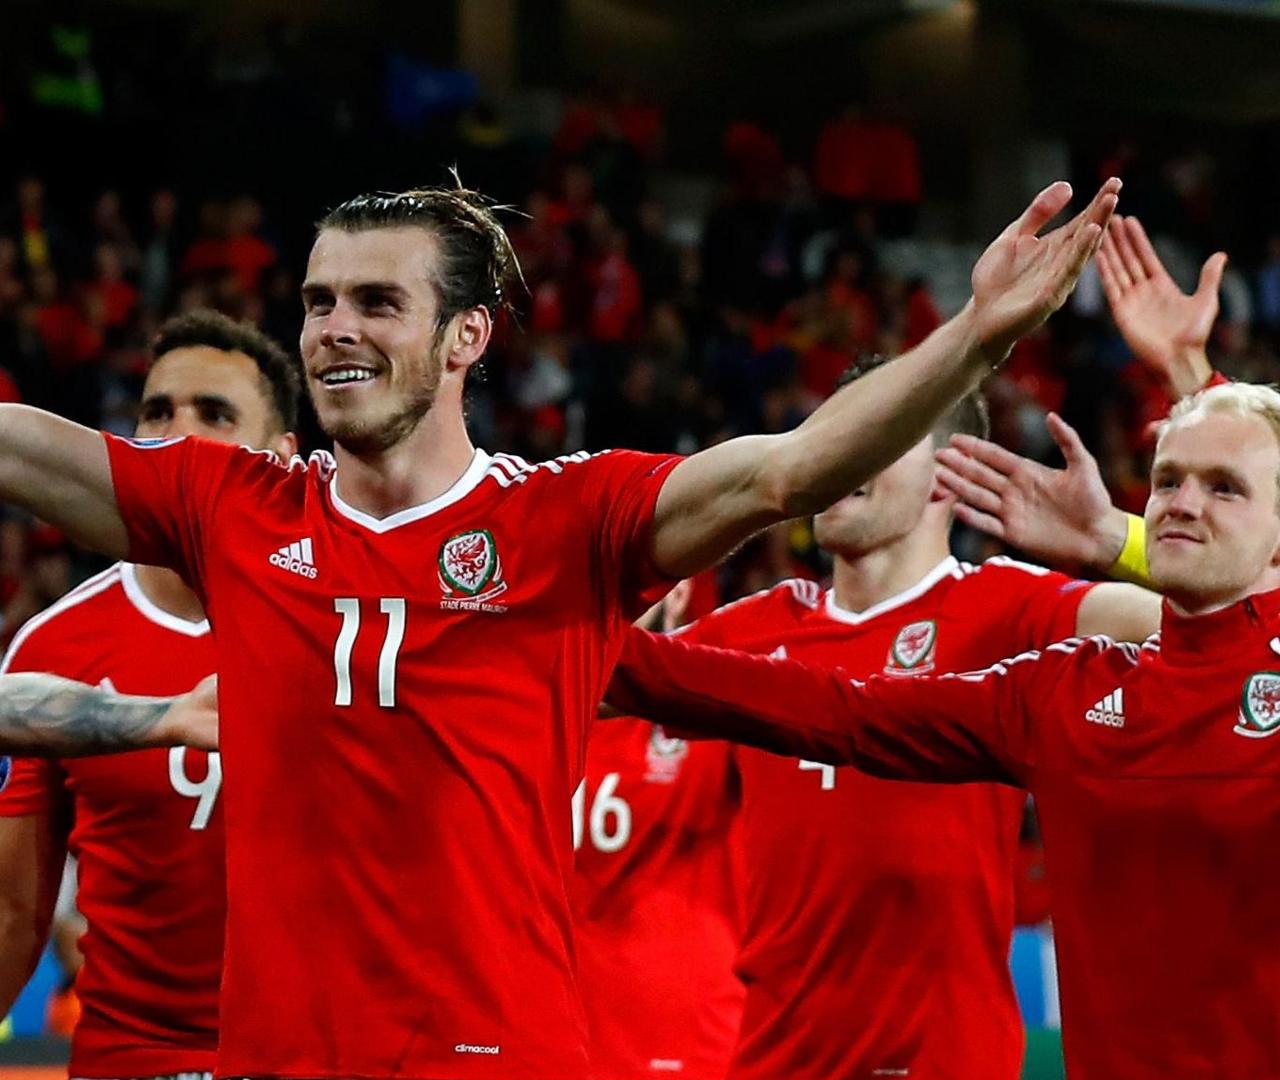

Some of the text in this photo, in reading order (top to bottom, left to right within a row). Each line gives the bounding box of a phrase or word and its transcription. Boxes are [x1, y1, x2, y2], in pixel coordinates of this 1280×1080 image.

[269, 553, 319, 579] adidas
[333, 597, 406, 708] 11
[1085, 709, 1125, 728] adidas
[168, 745, 223, 830] 9
